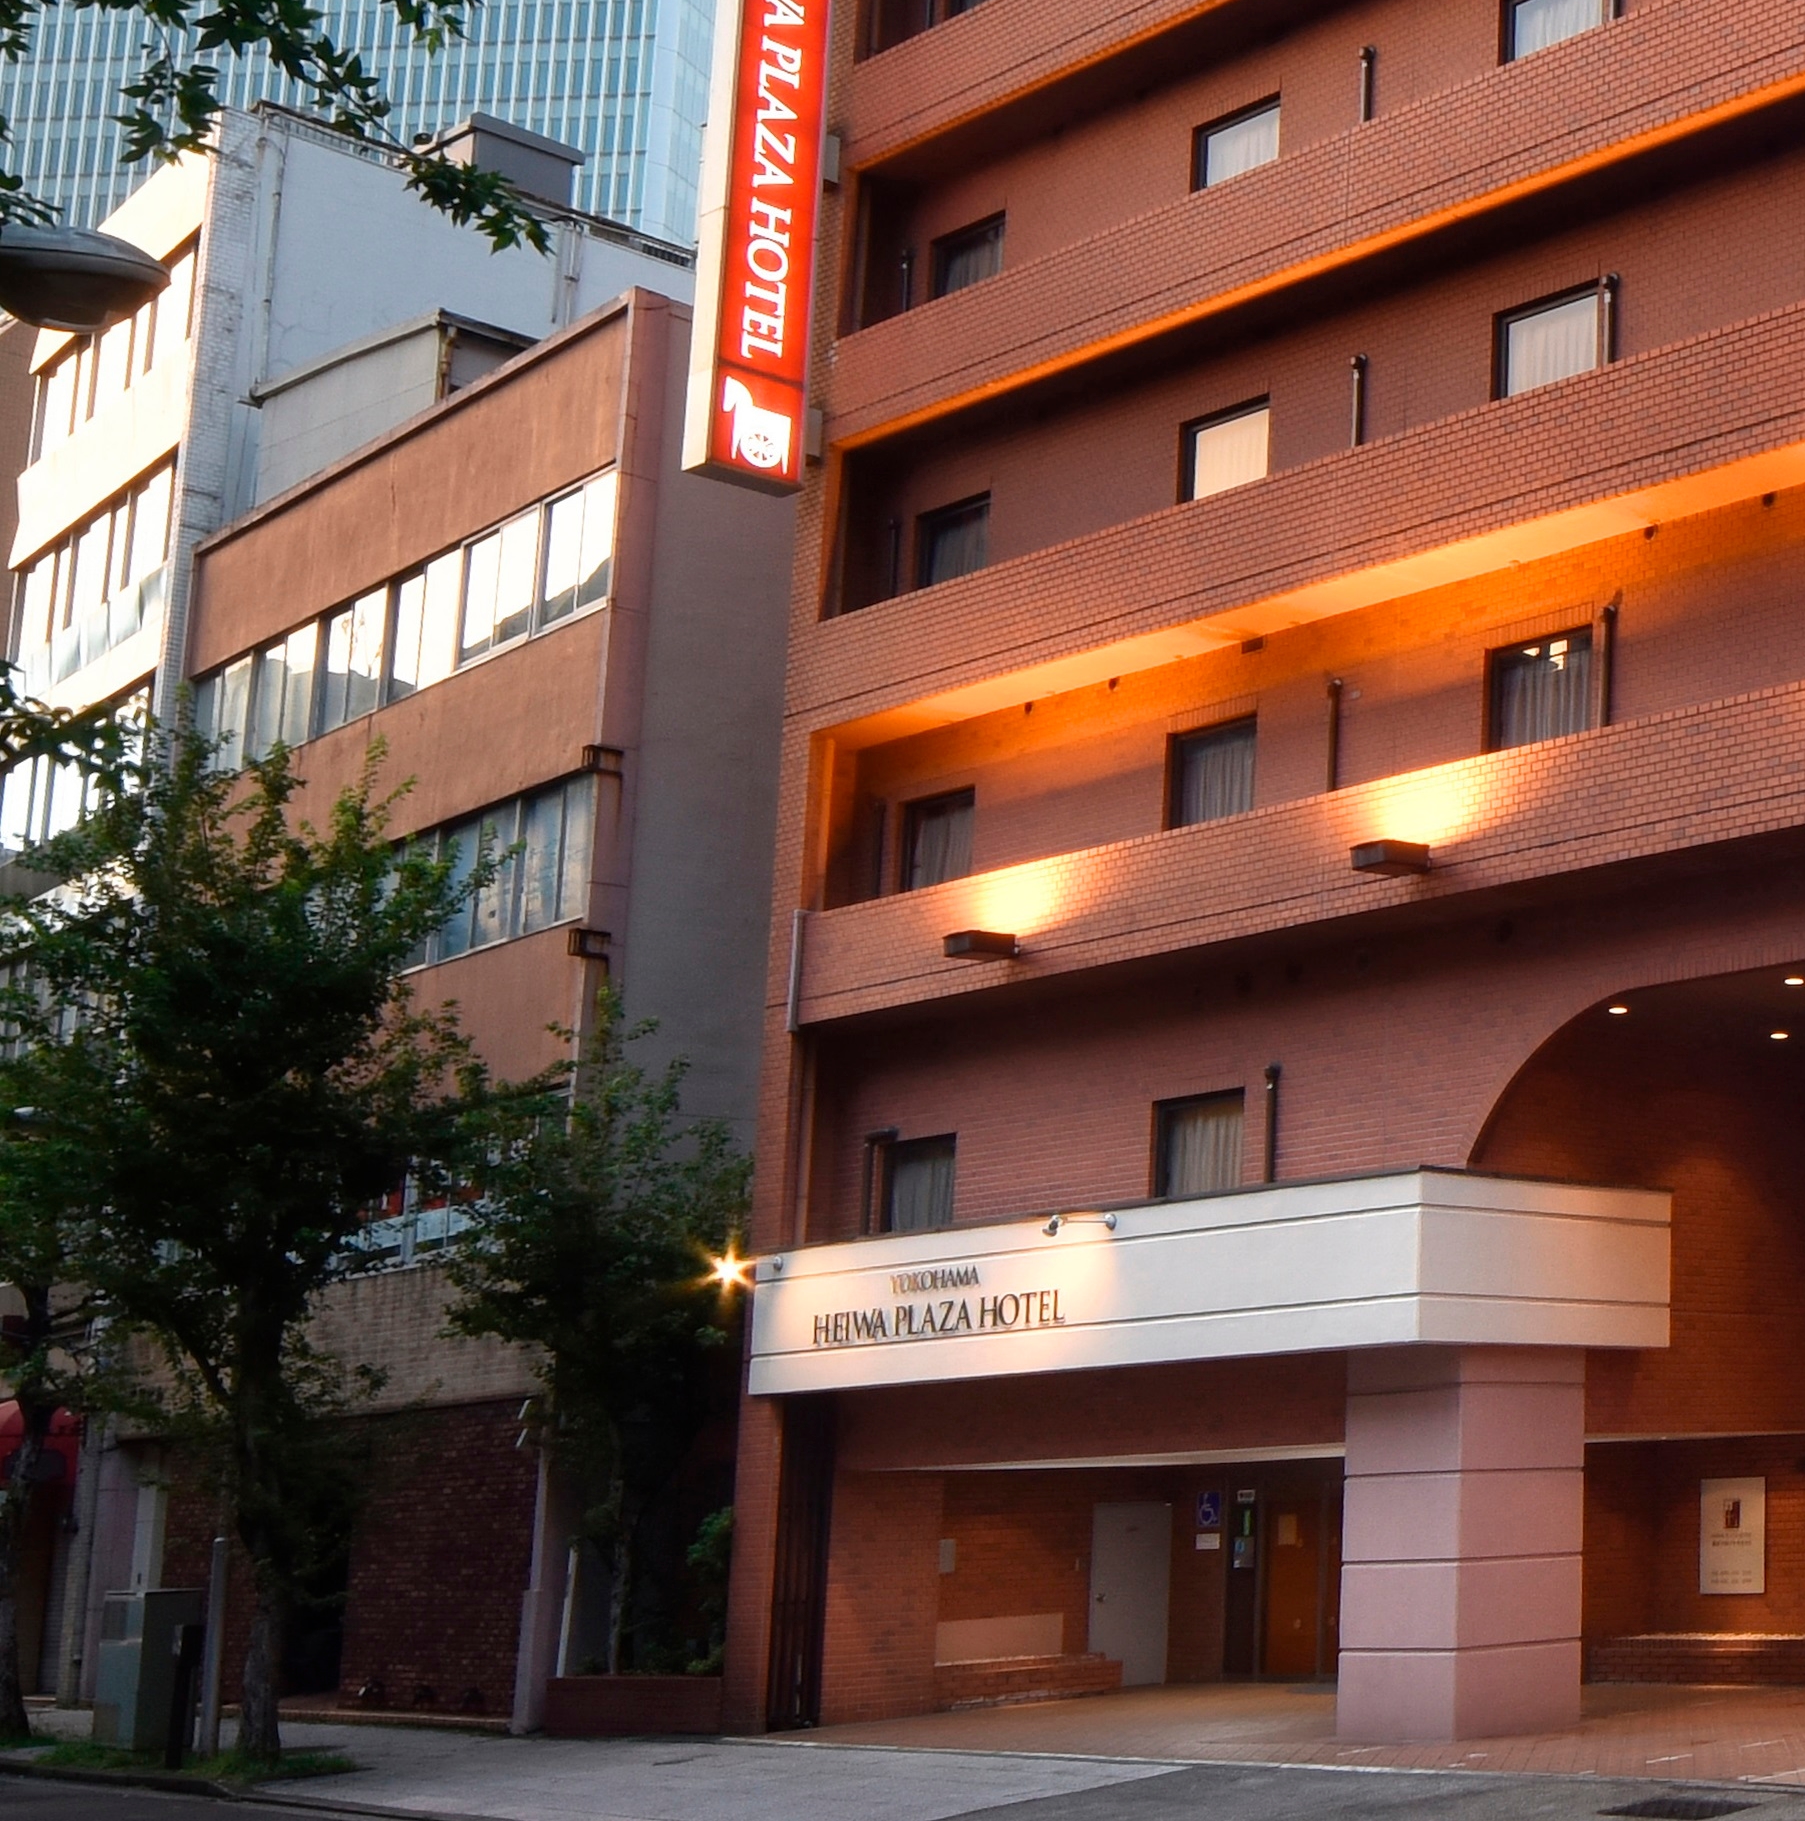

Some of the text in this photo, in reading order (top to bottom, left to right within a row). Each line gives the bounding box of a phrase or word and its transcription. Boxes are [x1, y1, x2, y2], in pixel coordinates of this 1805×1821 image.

[752, 36, 802, 187] PLAZA
[740, 198, 791, 358] HOTEL
[813, 1289, 1066, 1346] HEIWA PLAZA HOTEL
[890, 1264, 980, 1296] YOKOHAMA
